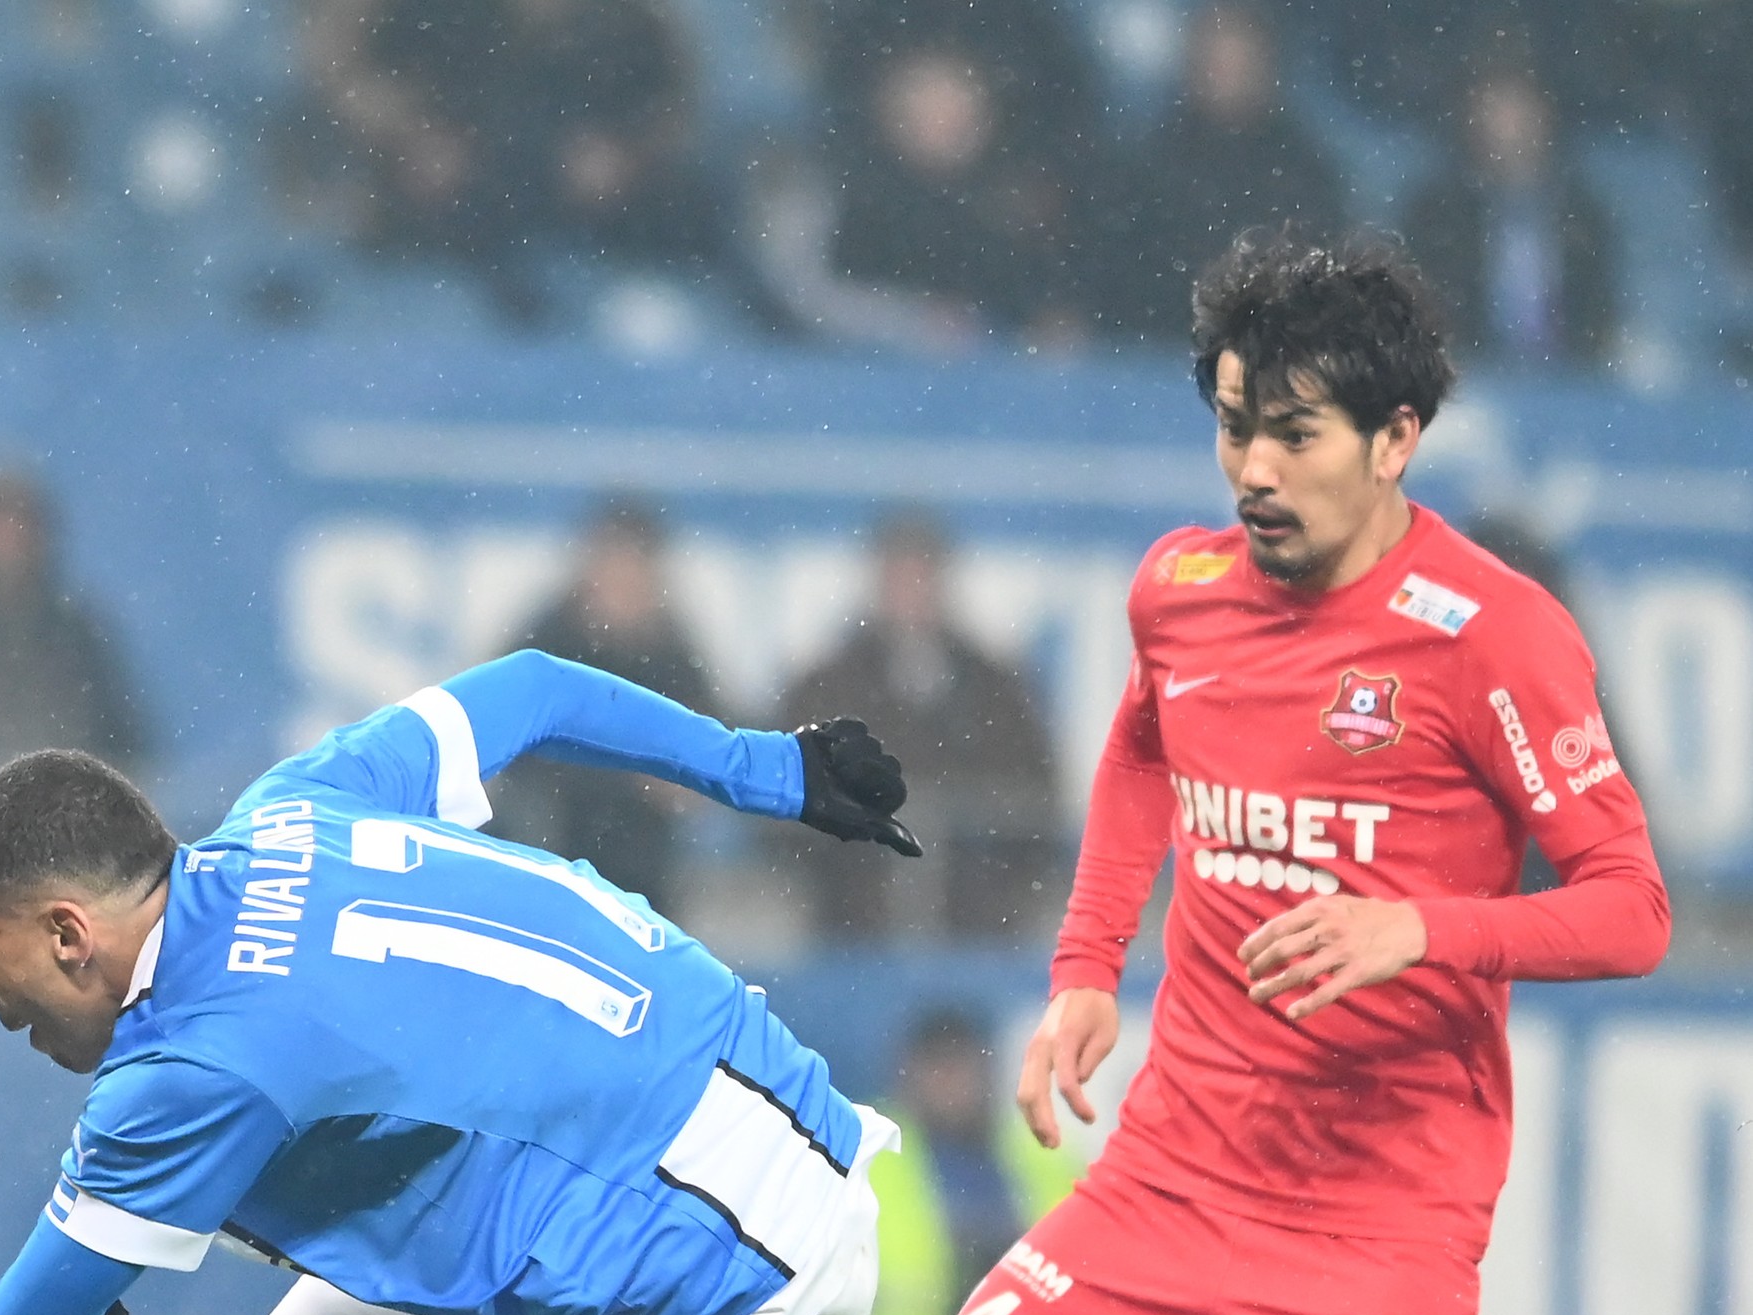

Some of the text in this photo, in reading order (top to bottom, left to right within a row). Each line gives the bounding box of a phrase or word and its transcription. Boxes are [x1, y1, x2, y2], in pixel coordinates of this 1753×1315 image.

[1488, 687, 1545, 794] ESCUDO
[1169, 772, 1391, 863] UNIBET
[331, 818, 666, 1039] 17
